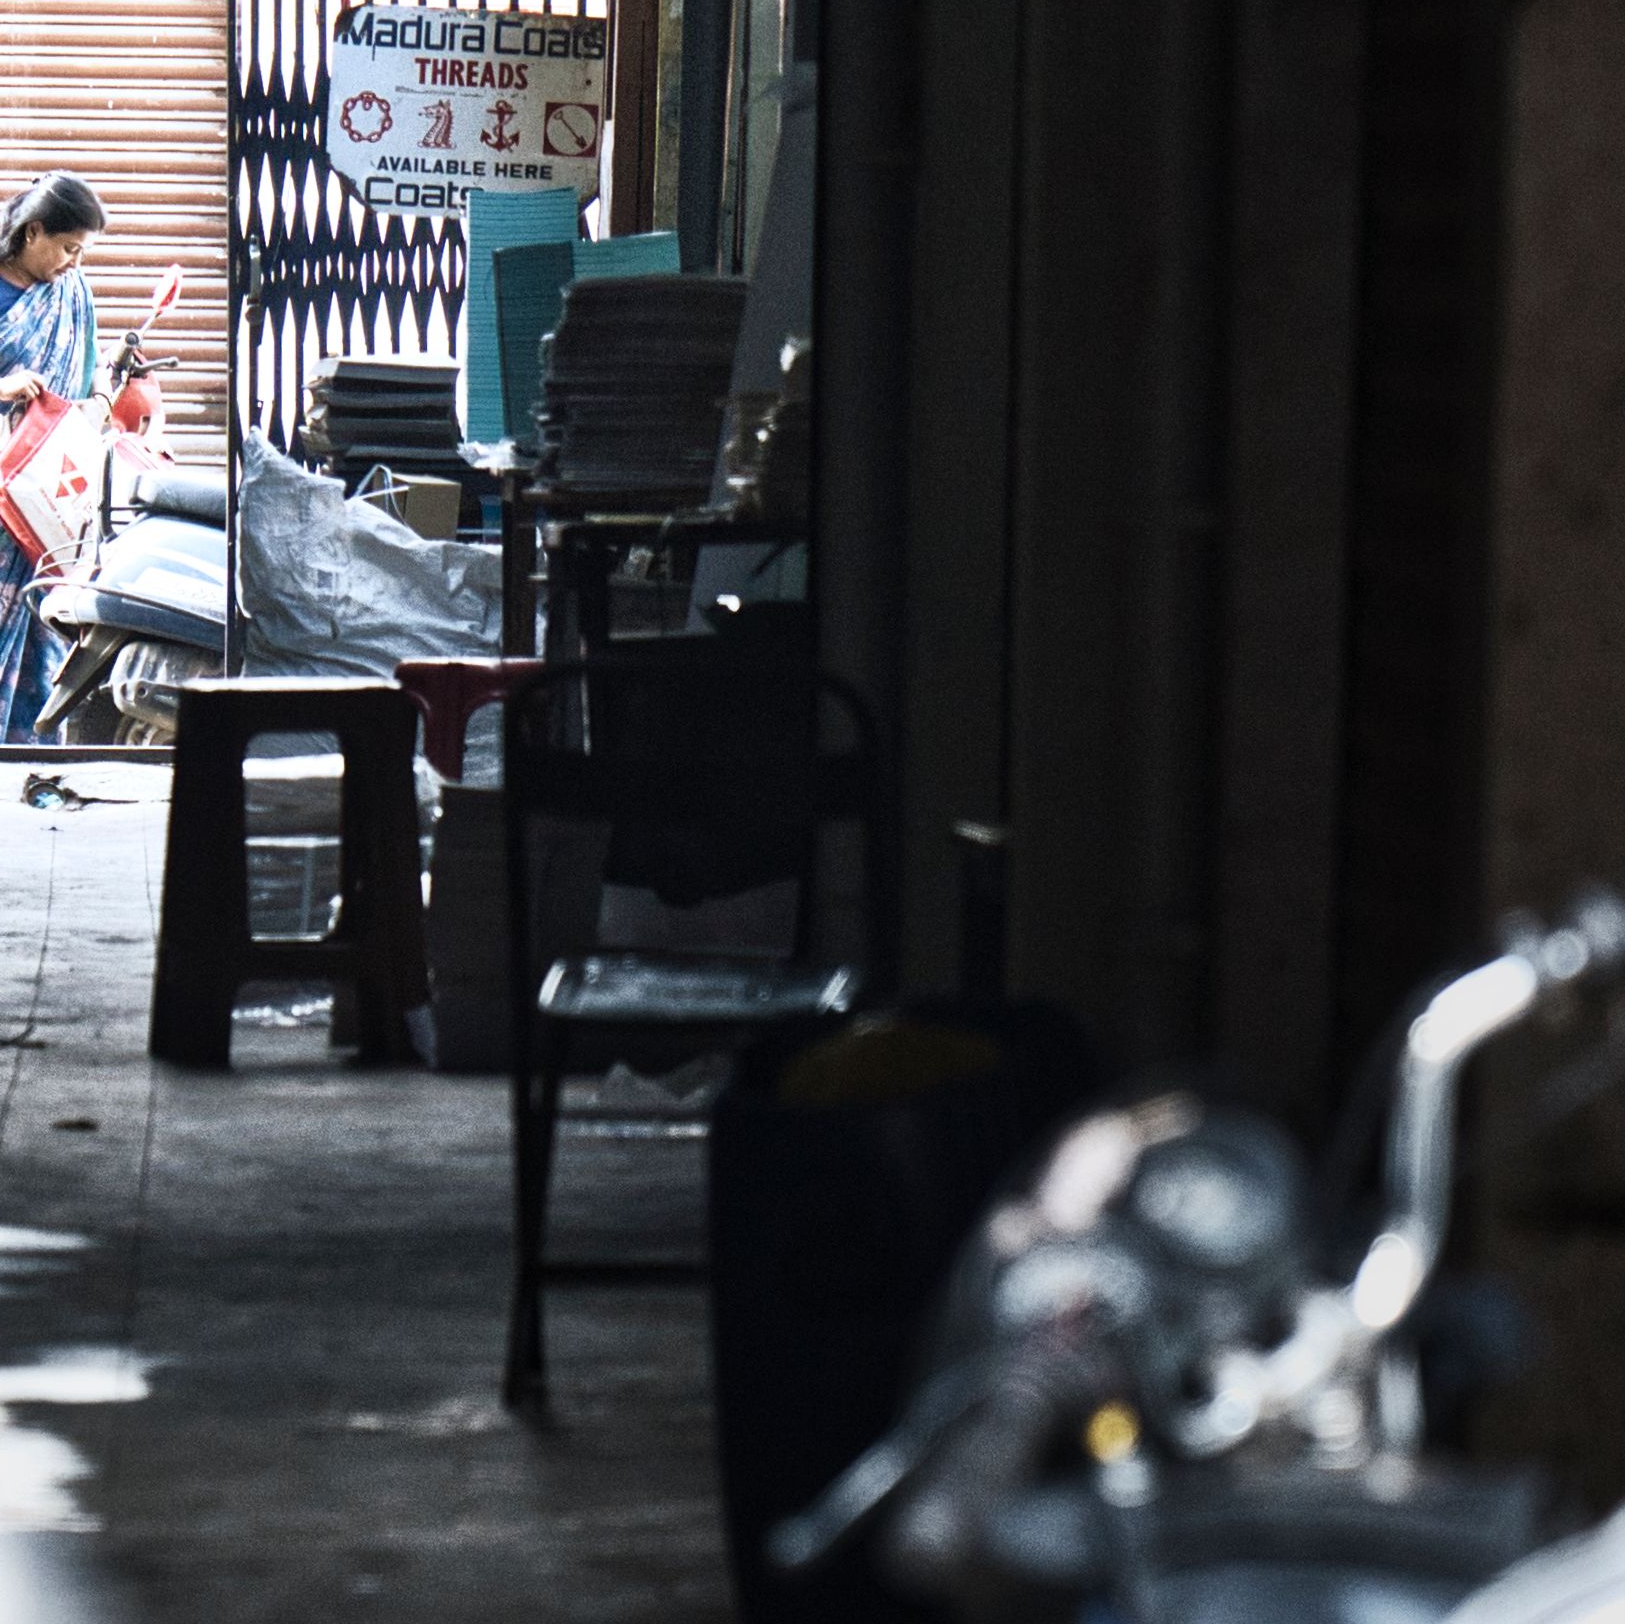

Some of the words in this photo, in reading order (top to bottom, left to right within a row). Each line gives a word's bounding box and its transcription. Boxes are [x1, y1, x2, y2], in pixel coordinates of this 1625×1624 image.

[340, 12, 485, 55] Madura
[493, 19, 605, 60] Coats
[414, 57, 529, 91] THREADS
[376, 155, 486, 177] AVAILABLE
[493, 162, 554, 181] HERE
